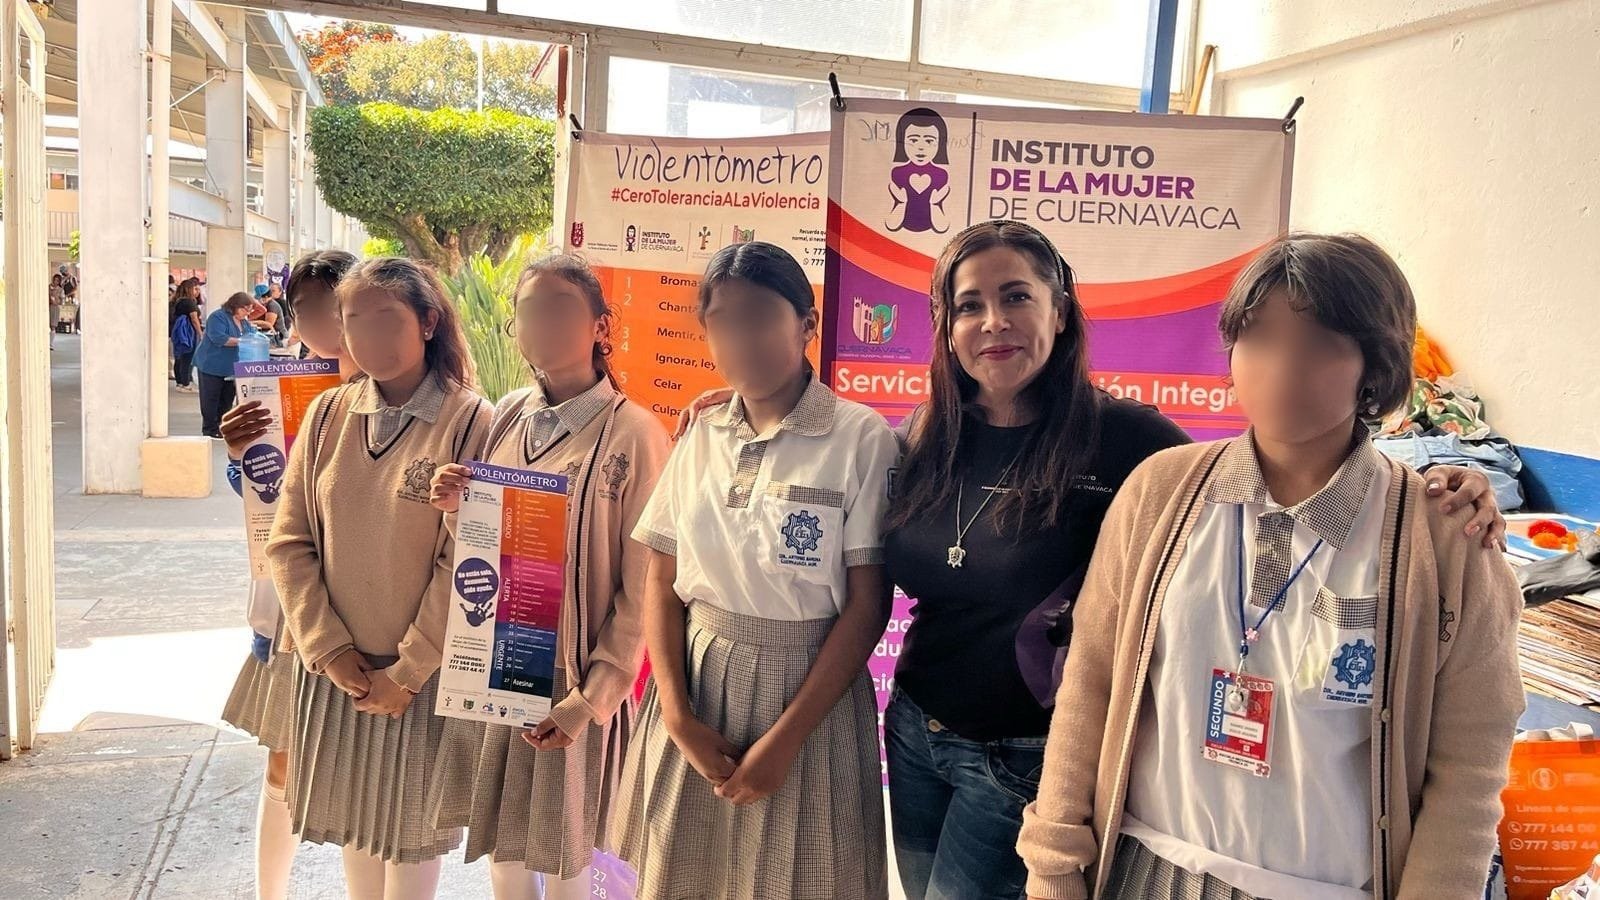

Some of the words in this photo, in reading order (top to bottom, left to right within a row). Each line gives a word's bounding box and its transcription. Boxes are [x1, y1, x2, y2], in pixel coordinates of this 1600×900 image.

[991, 139, 1155, 169] INSTITUTO
[989, 168, 1031, 192] DE
[1038, 170, 1079, 195] LA
[1084, 172, 1195, 199] MUJER
[611, 187, 820, 210] #CeroToleranciaALaViolencia
[989, 197, 1027, 221] DE
[1036, 200, 1241, 230] CUERNAVACA
[642, 231, 670, 239] INSTITUTO
[624, 294, 632, 305] 2
[622, 327, 629, 338] 3
[657, 327, 696, 341] Mentir,
[621, 341, 629, 352] 4
[837, 344, 912, 353] CUERNAVACA
[655, 353, 698, 368] Ignorar,
[244, 362, 330, 374] VIOLENTÓMETRO
[620, 372, 627, 383] 5
[654, 378, 682, 390] Celar
[471, 466, 558, 488] VIOLENTÓMETRO
[503, 578, 511, 602] ALERTA
[497, 640, 505, 671] URGENTE
[1210, 680, 1224, 738] SEGUNDO
[1523, 823, 1546, 833] 777
[1525, 840, 1548, 850] 777
[592, 868, 607, 882] 27
[592, 883, 607, 899] 28
